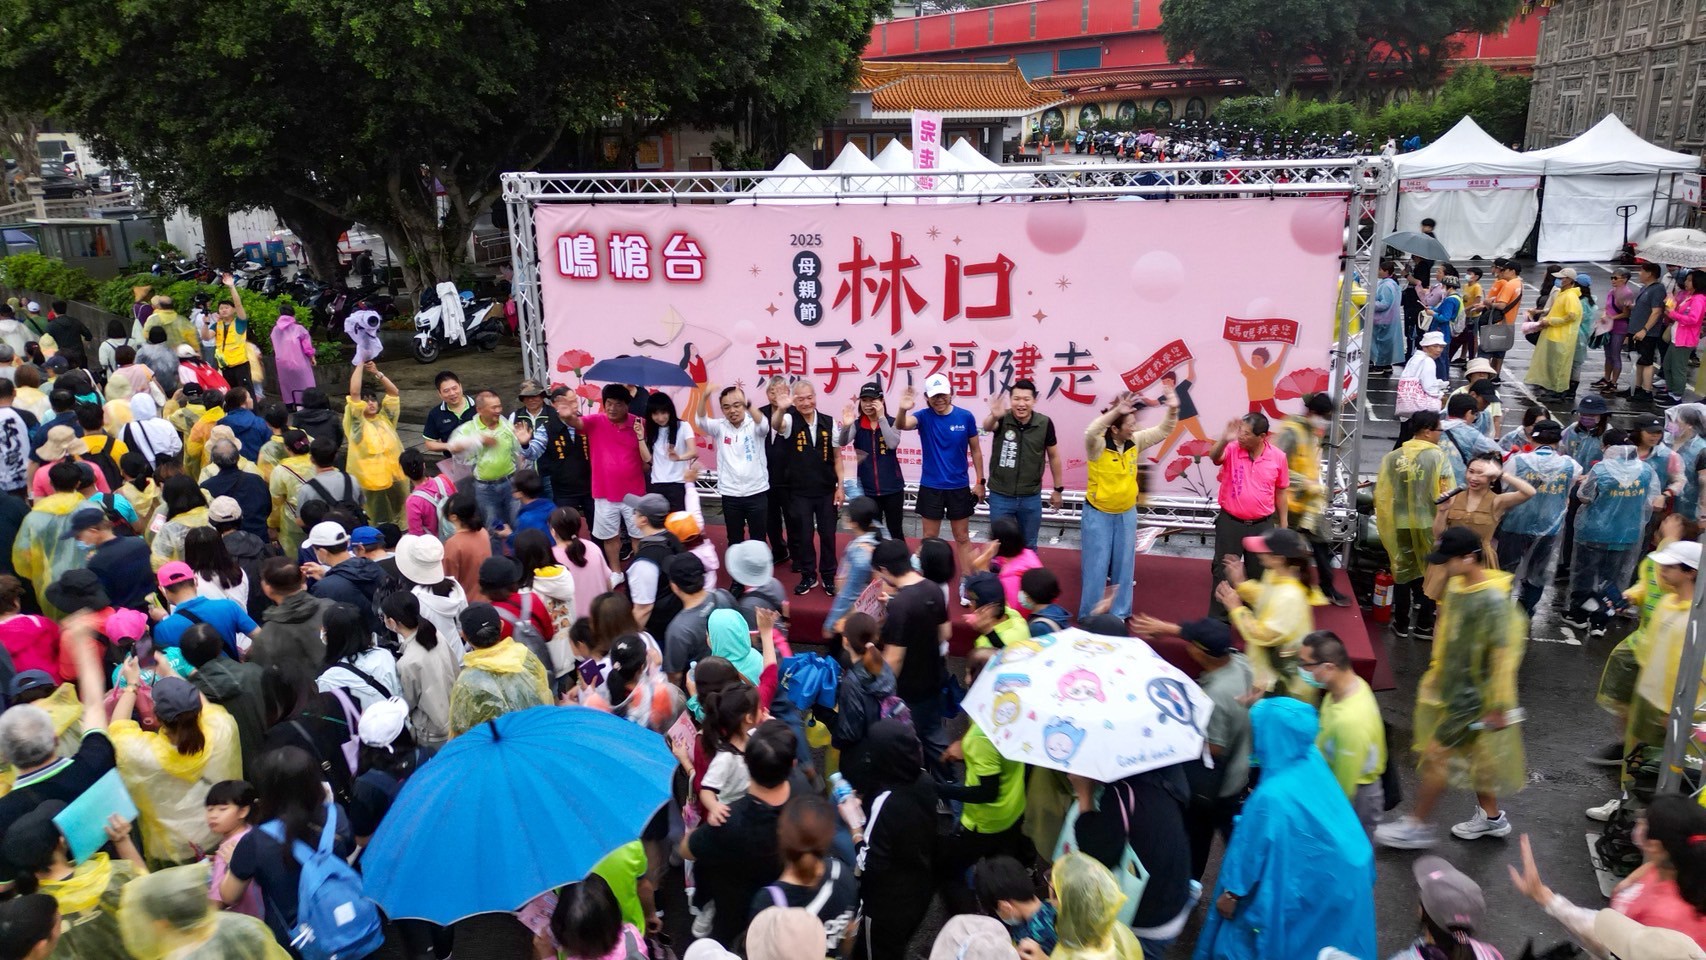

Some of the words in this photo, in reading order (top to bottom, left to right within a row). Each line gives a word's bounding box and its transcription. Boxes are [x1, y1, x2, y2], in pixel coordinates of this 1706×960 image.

[556, 232, 706, 281] 鳴槍台
[790, 233, 822, 246] 2025
[797, 257, 817, 321] 母親節
[832, 231, 1015, 336] 林口
[755, 336, 1100, 404] 親子祈福健走
